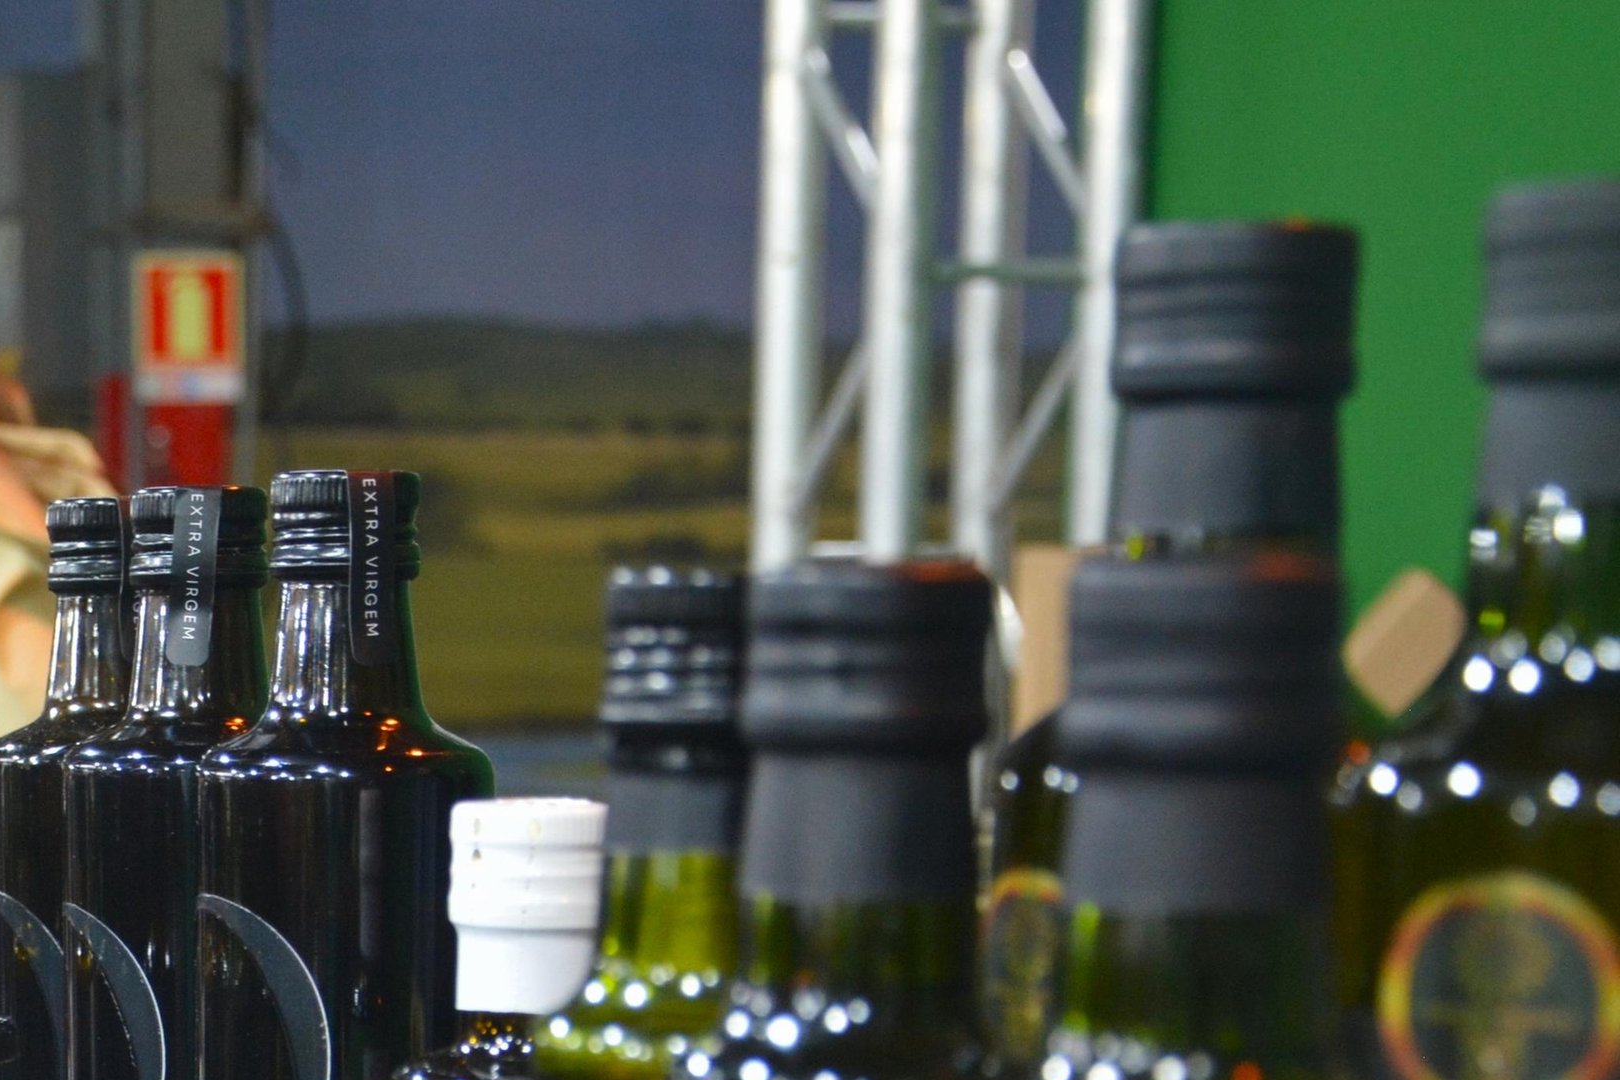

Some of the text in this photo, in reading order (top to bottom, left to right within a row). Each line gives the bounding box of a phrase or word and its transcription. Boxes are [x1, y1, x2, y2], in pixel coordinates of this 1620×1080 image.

[181, 494, 204, 640] EXTRA VIRGEM
[362, 478, 379, 638] EXTRA VIRGEM
